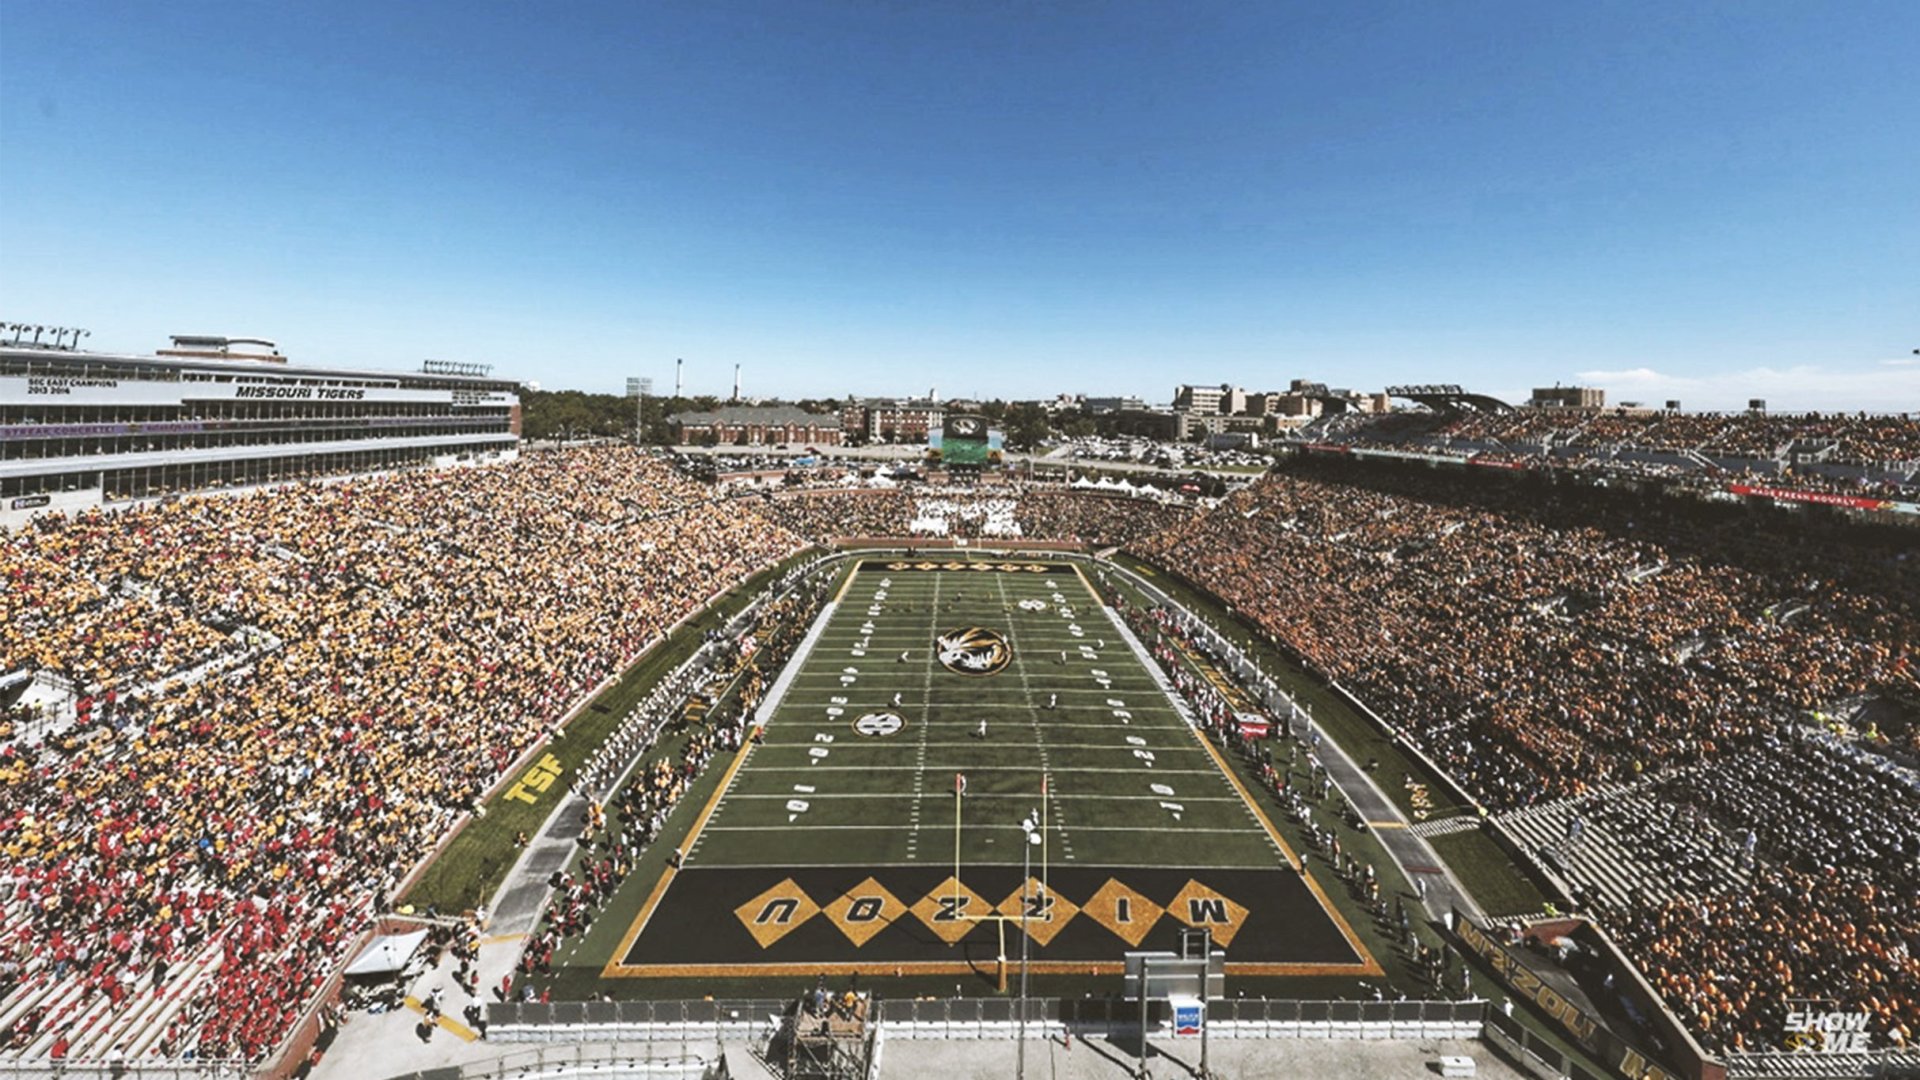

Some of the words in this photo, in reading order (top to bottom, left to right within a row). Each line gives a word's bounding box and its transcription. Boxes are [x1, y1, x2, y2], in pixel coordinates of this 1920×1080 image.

[28, 386, 48, 394] 2013
[47, 379, 68, 387] EAST
[69, 380, 118, 388] CHAMPIONS
[235, 386, 312, 399] MISSOURI
[317, 388, 366, 400] TIGERS
[1750, 488, 1776, 497] MADE
[1779, 490, 1811, 501] FRESH
[1812, 494, 1856, 505] HOURLY
[502, 753, 563, 805] TSF
[786, 784, 816, 813] 10
[1150, 783, 1185, 812] 10
[752, 896, 1231, 925] MIZZOU
